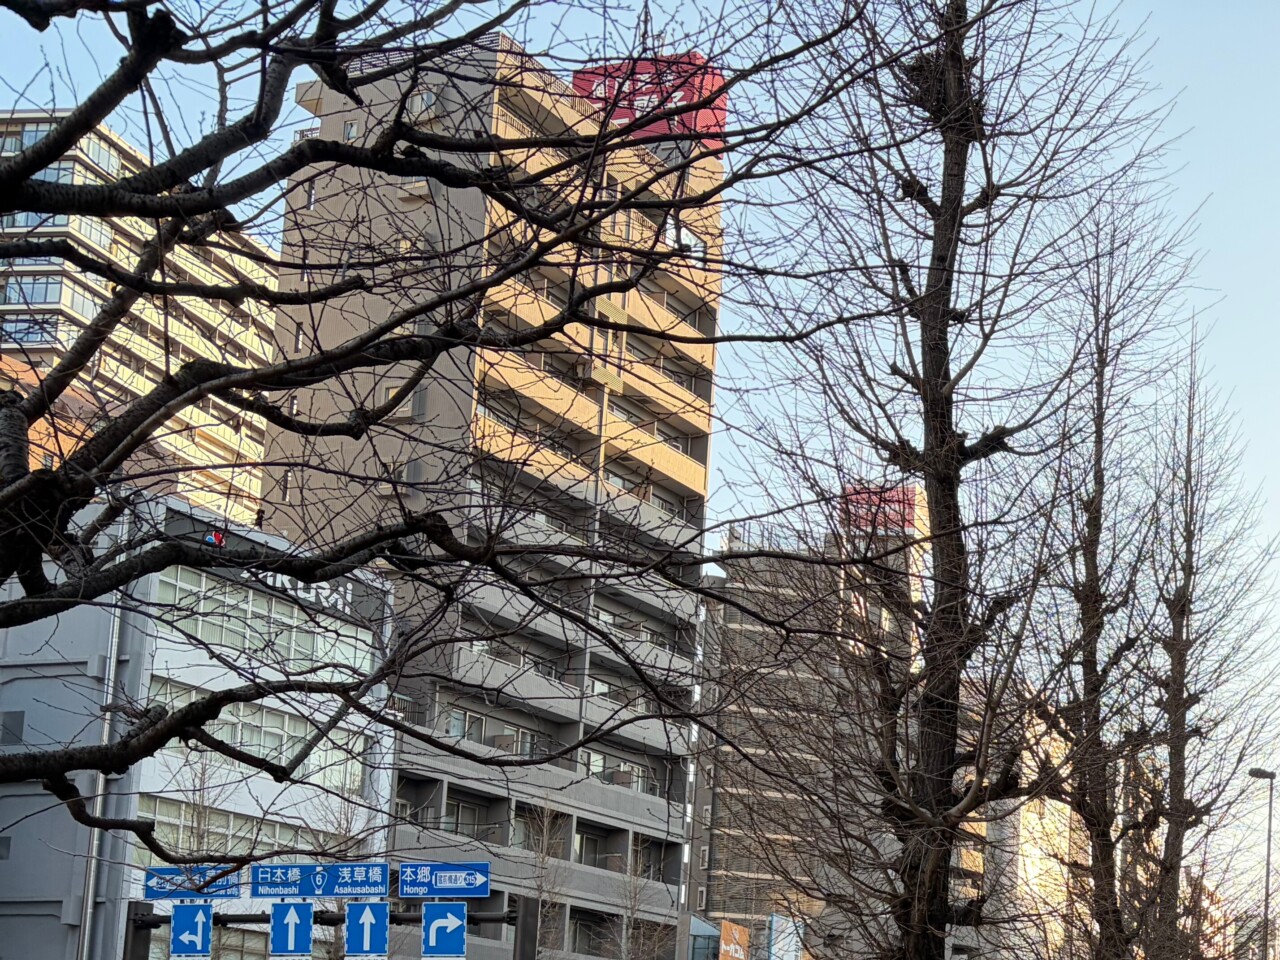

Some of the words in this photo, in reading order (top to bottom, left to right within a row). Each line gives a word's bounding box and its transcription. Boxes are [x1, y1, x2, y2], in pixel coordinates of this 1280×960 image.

[258, 867, 301, 884] 日本橋
[316, 874, 323, 885] 6
[338, 866, 383, 884] 浅草橋
[401, 866, 431, 883] 本郷
[465, 875, 477, 884] 315
[258, 885, 299, 895] Nihonbashi
[333, 884, 386, 895] Asakusabashi
[403, 885, 429, 896] Hongo
